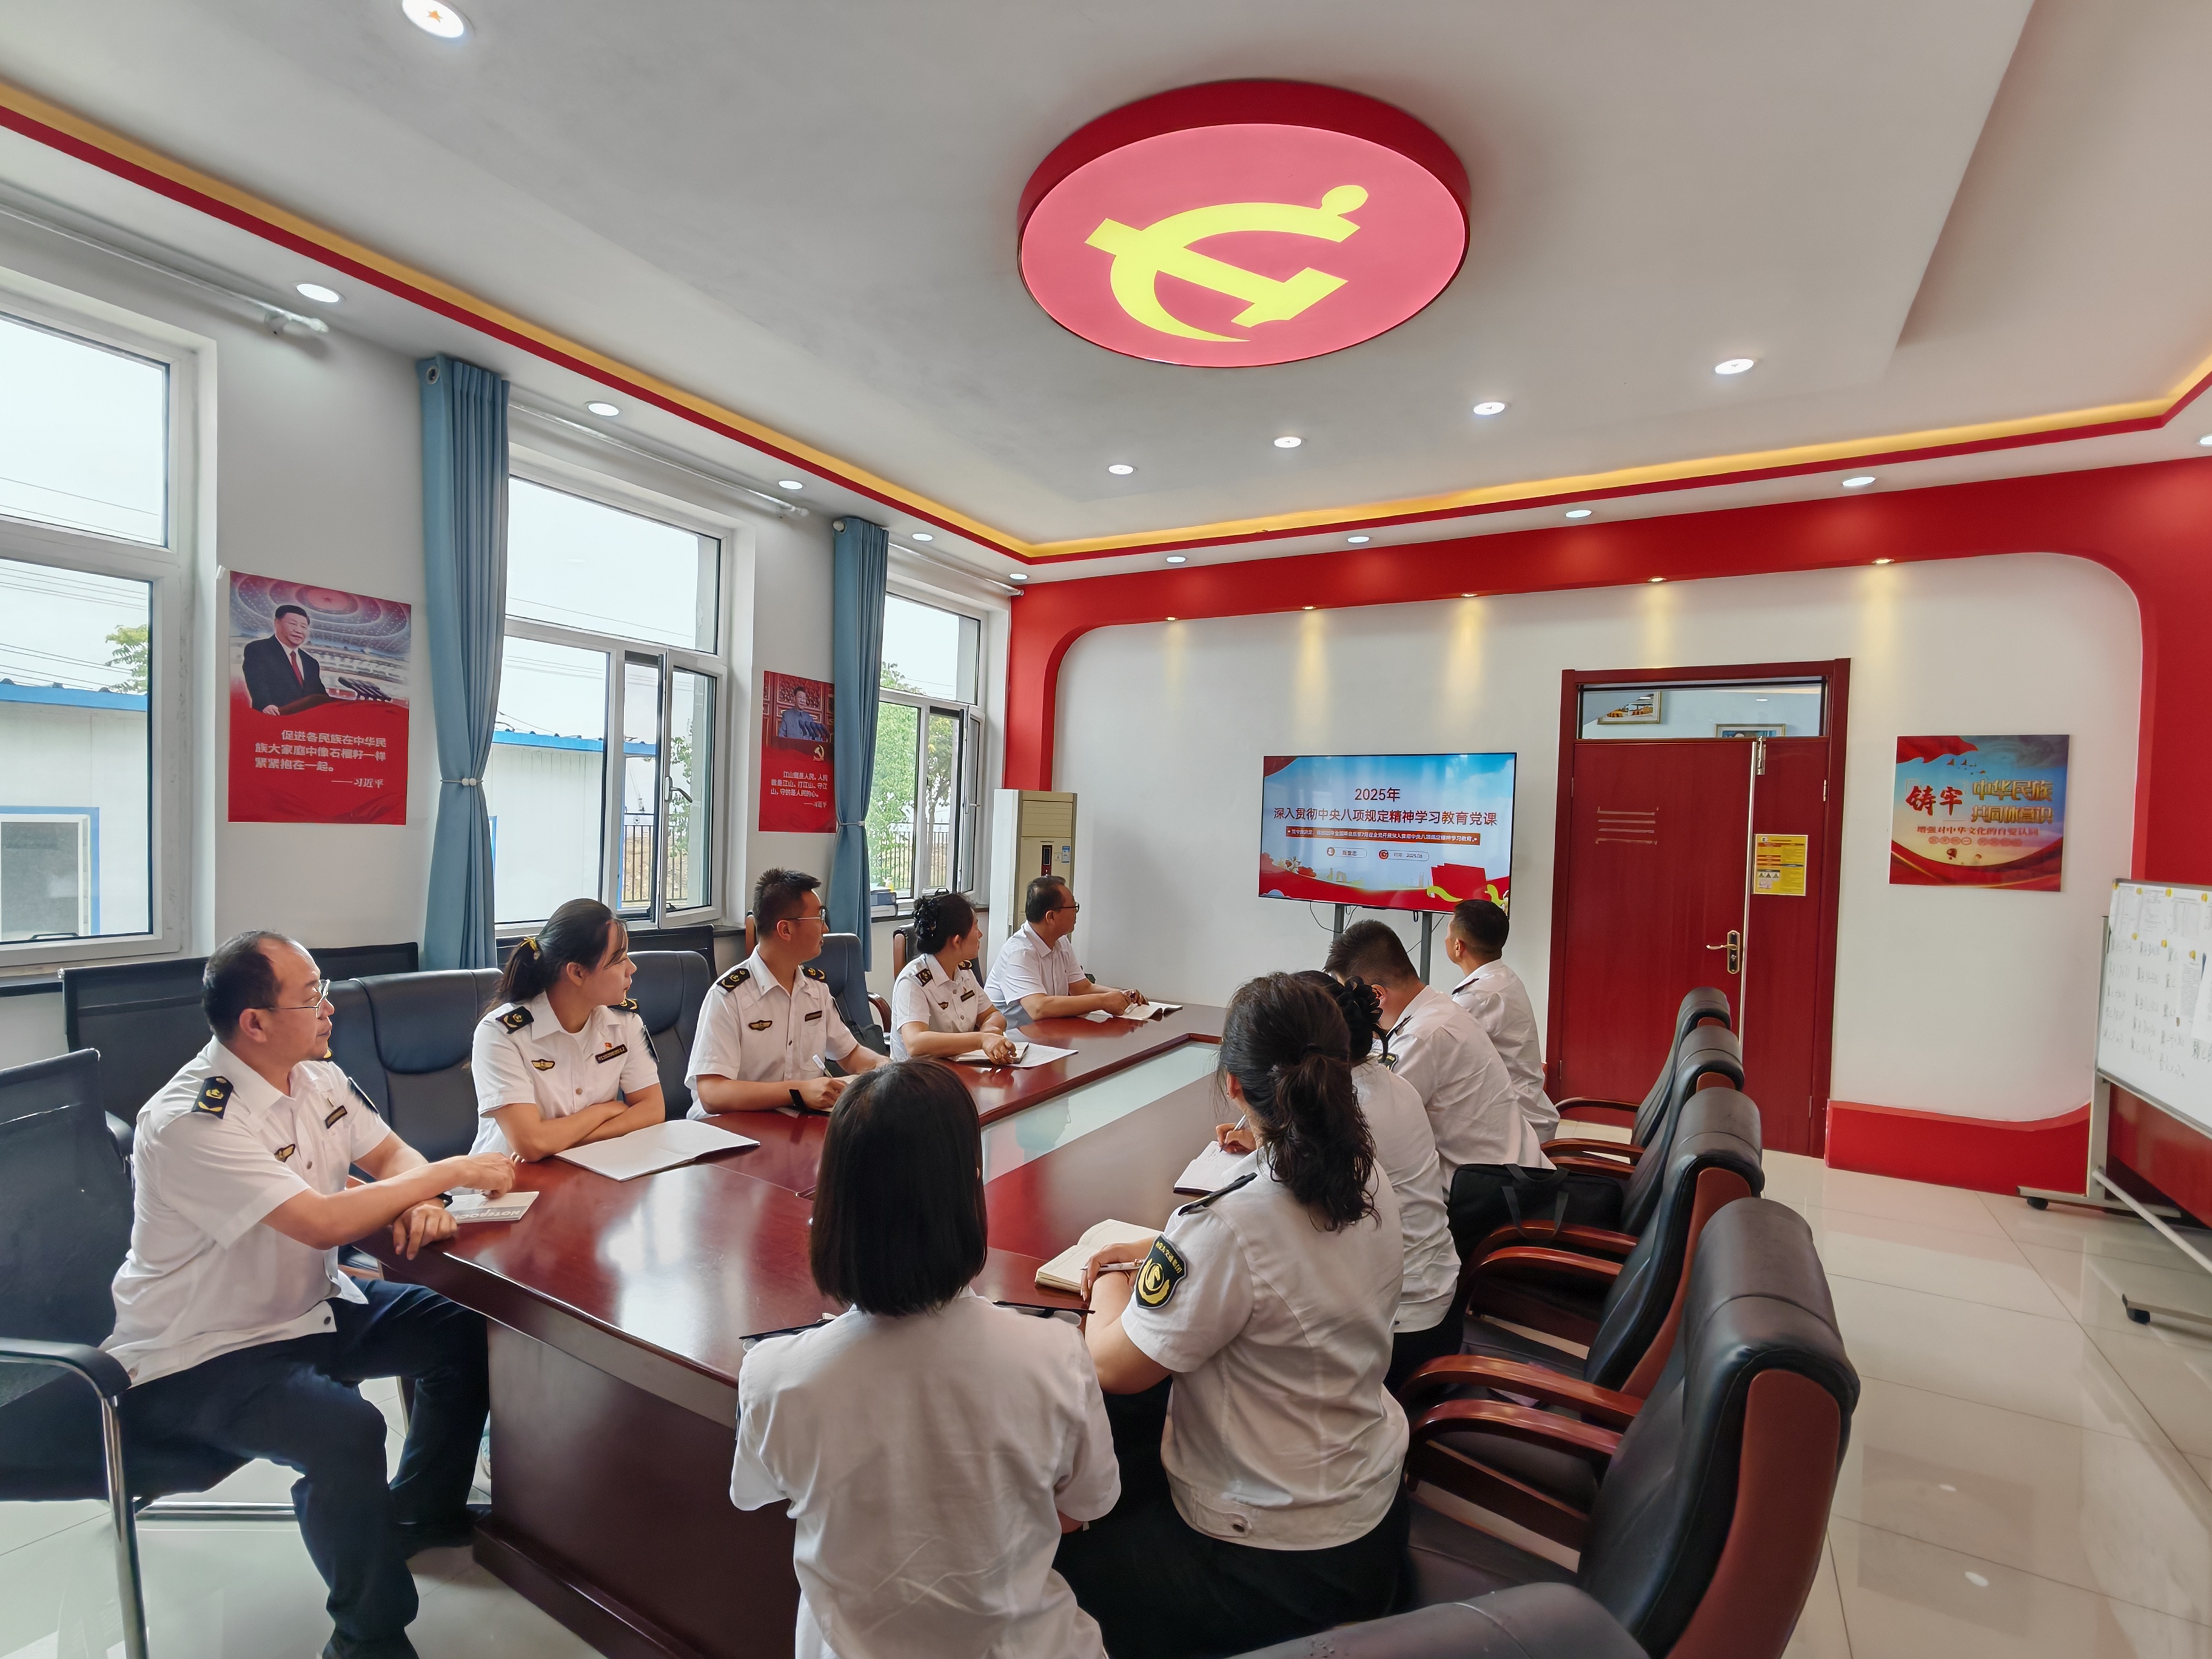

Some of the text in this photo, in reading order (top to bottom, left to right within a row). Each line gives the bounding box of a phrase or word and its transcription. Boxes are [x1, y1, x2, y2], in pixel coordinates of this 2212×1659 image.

[281, 729, 386, 748] 促进各民族在中华民
[255, 743, 386, 761] 族大家庭中像石榴籽一样
[255, 757, 334, 773] 紧紧抱在一起。
[1355, 786, 1401, 802] 2025年
[1972, 779, 2053, 802] 中华民族
[1905, 785, 1963, 816] 铸牢
[1273, 806, 1498, 826] 深入贯彻中央八项规定精神学习教育党课
[1971, 805, 2053, 824] 共同体意识
